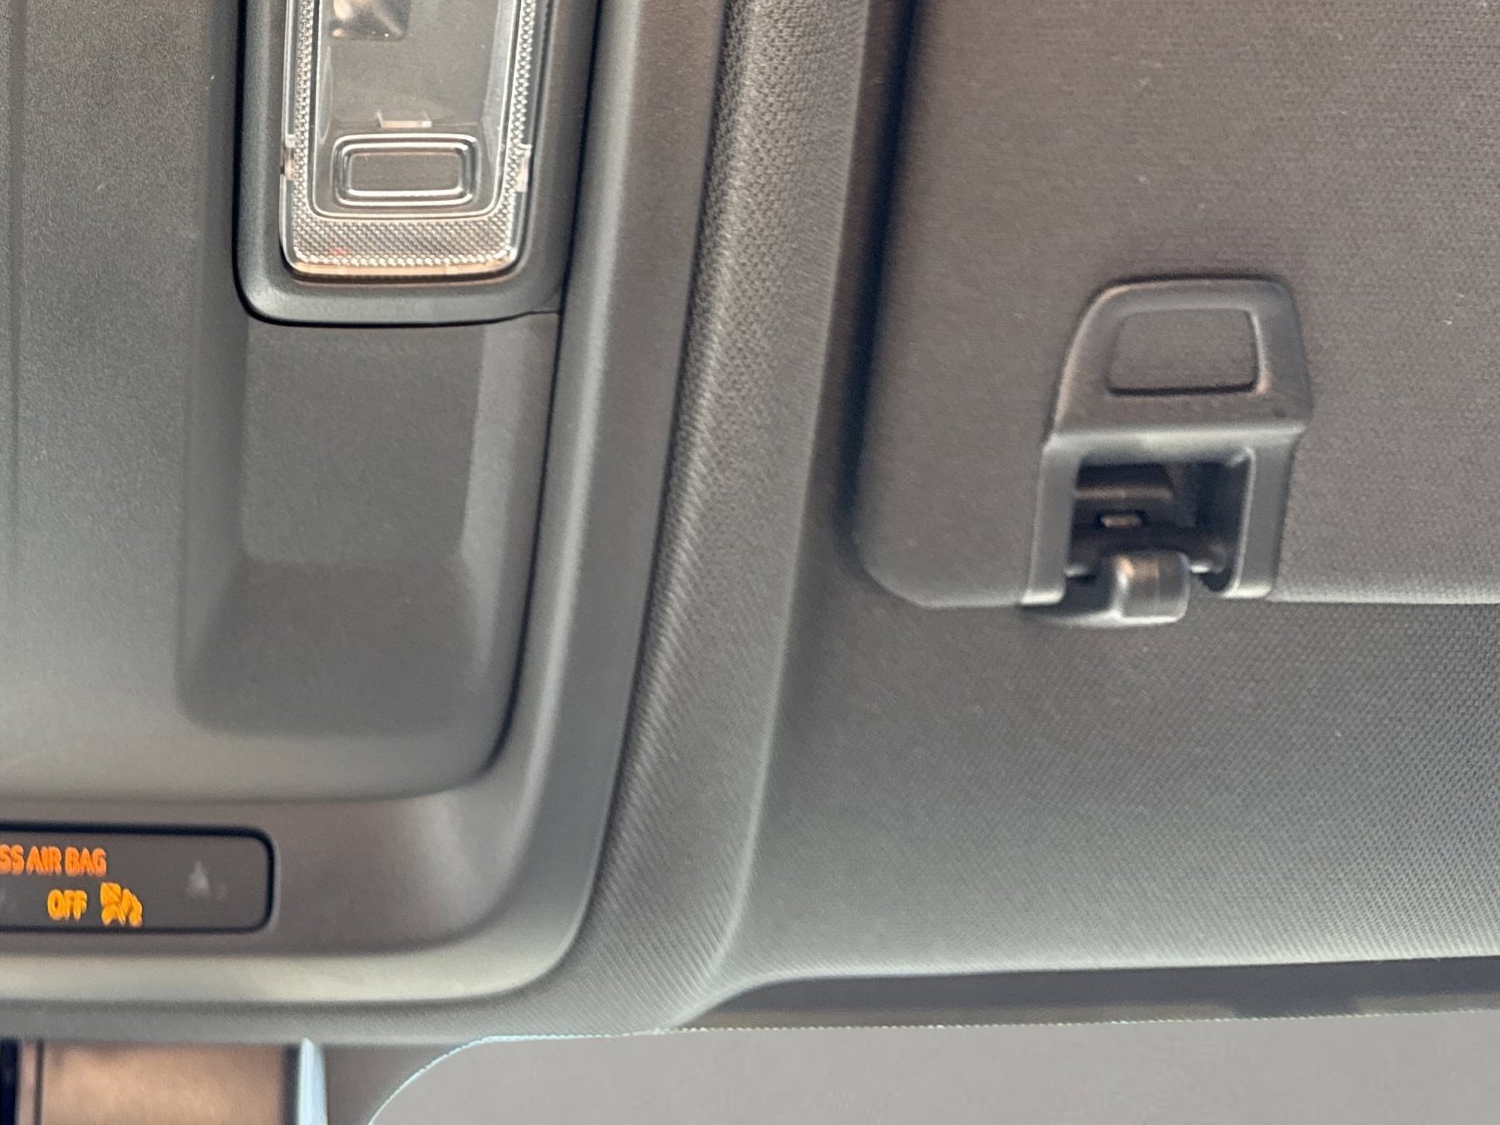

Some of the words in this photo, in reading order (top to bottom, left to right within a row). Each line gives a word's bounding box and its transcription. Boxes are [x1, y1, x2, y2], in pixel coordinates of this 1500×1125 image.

[26, 846, 62, 875] AIR
[64, 847, 107, 876] BAG
[47, 889, 88, 921] OFF
